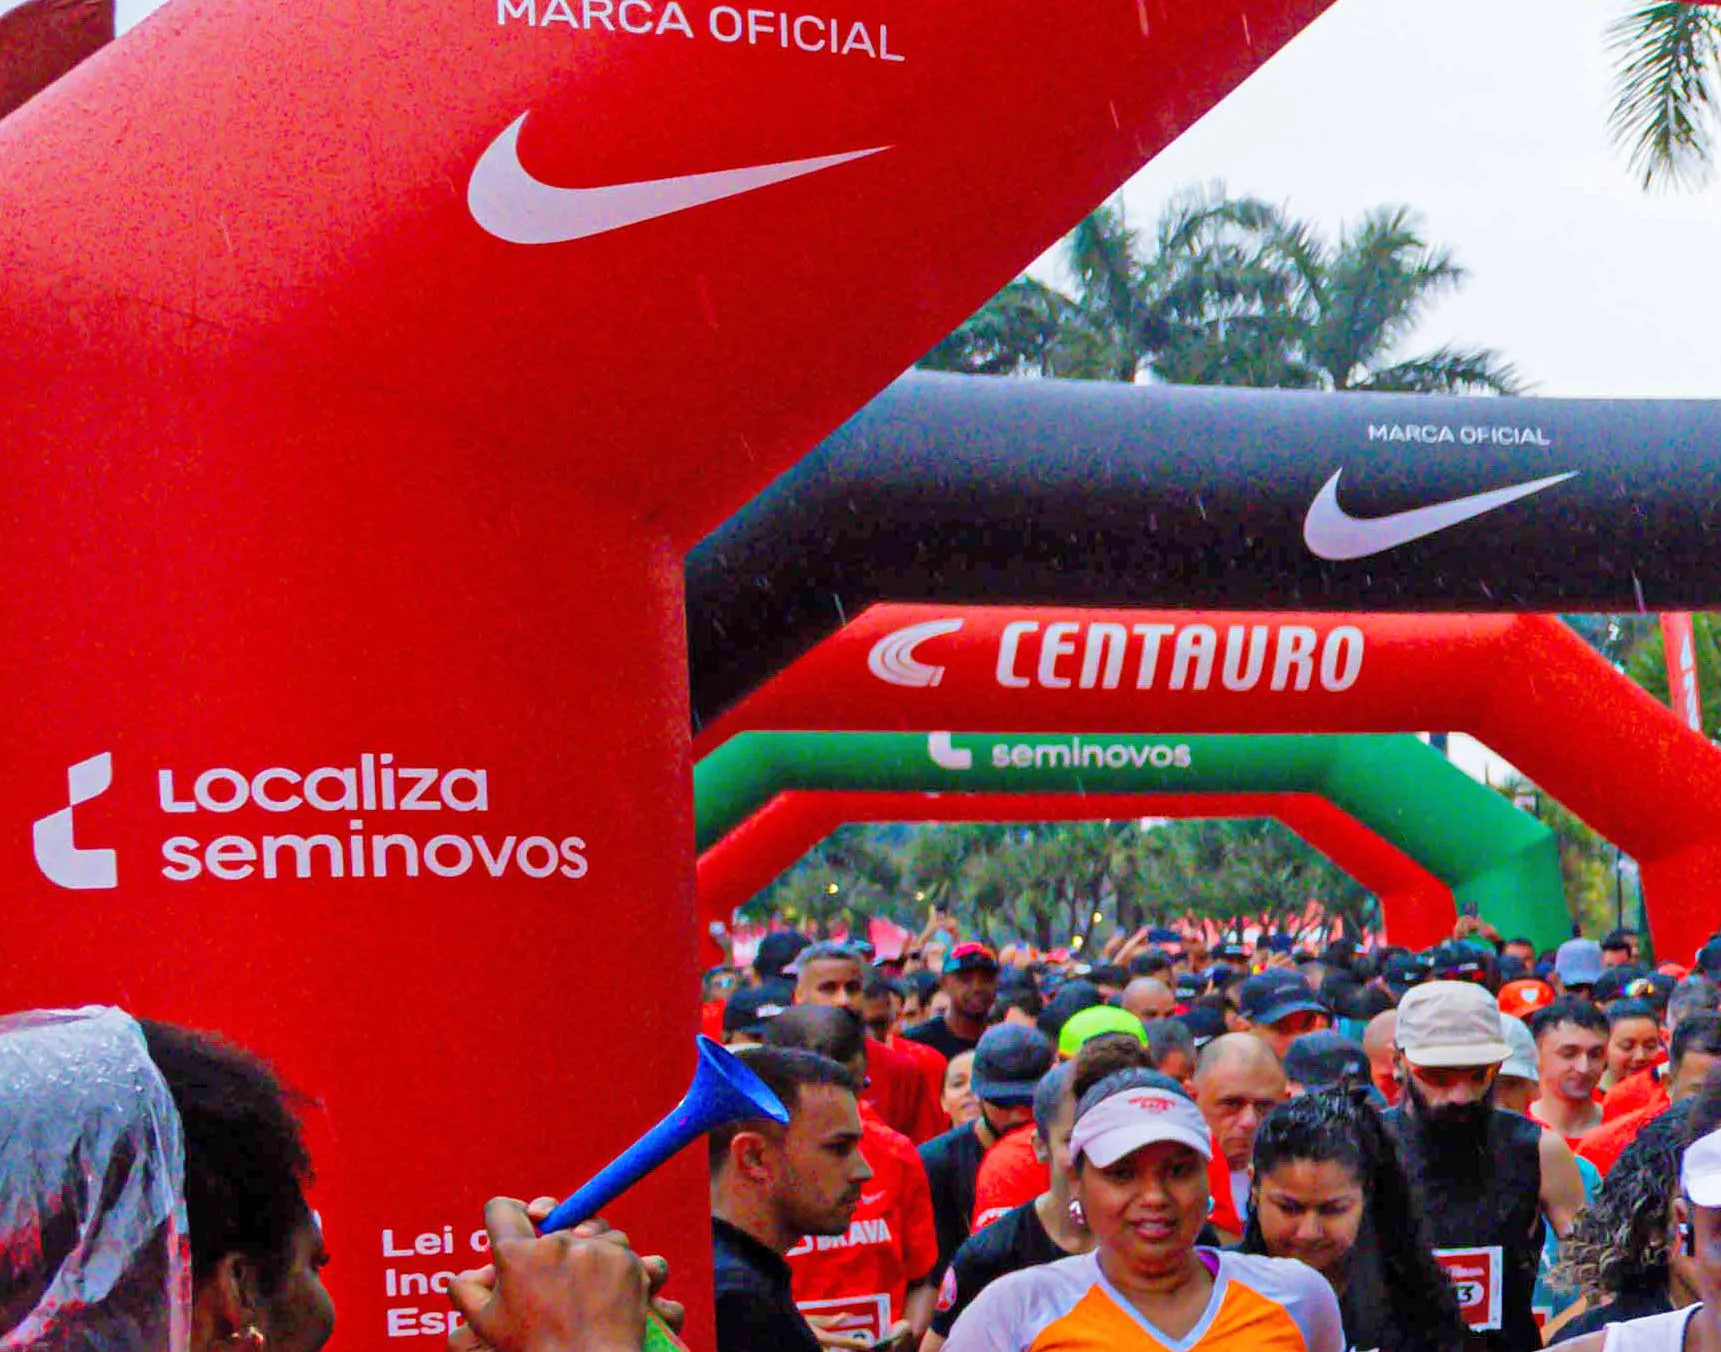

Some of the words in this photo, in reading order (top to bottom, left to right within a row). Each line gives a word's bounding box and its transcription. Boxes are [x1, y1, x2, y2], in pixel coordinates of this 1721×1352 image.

[497, 0, 694, 39] MARCA
[709, 5, 906, 62] OFICIAL
[1367, 423, 1456, 444] MARCA
[1460, 426, 1551, 446] OFICIAL
[995, 621, 1365, 693] CENTAURO
[991, 735, 1192, 771] seminovos
[158, 752, 489, 813] Localiza
[160, 818, 588, 881] seminovos
[382, 1225, 454, 1257] Lei
[385, 1268, 455, 1297] Inc
[387, 1307, 467, 1338] Esp
